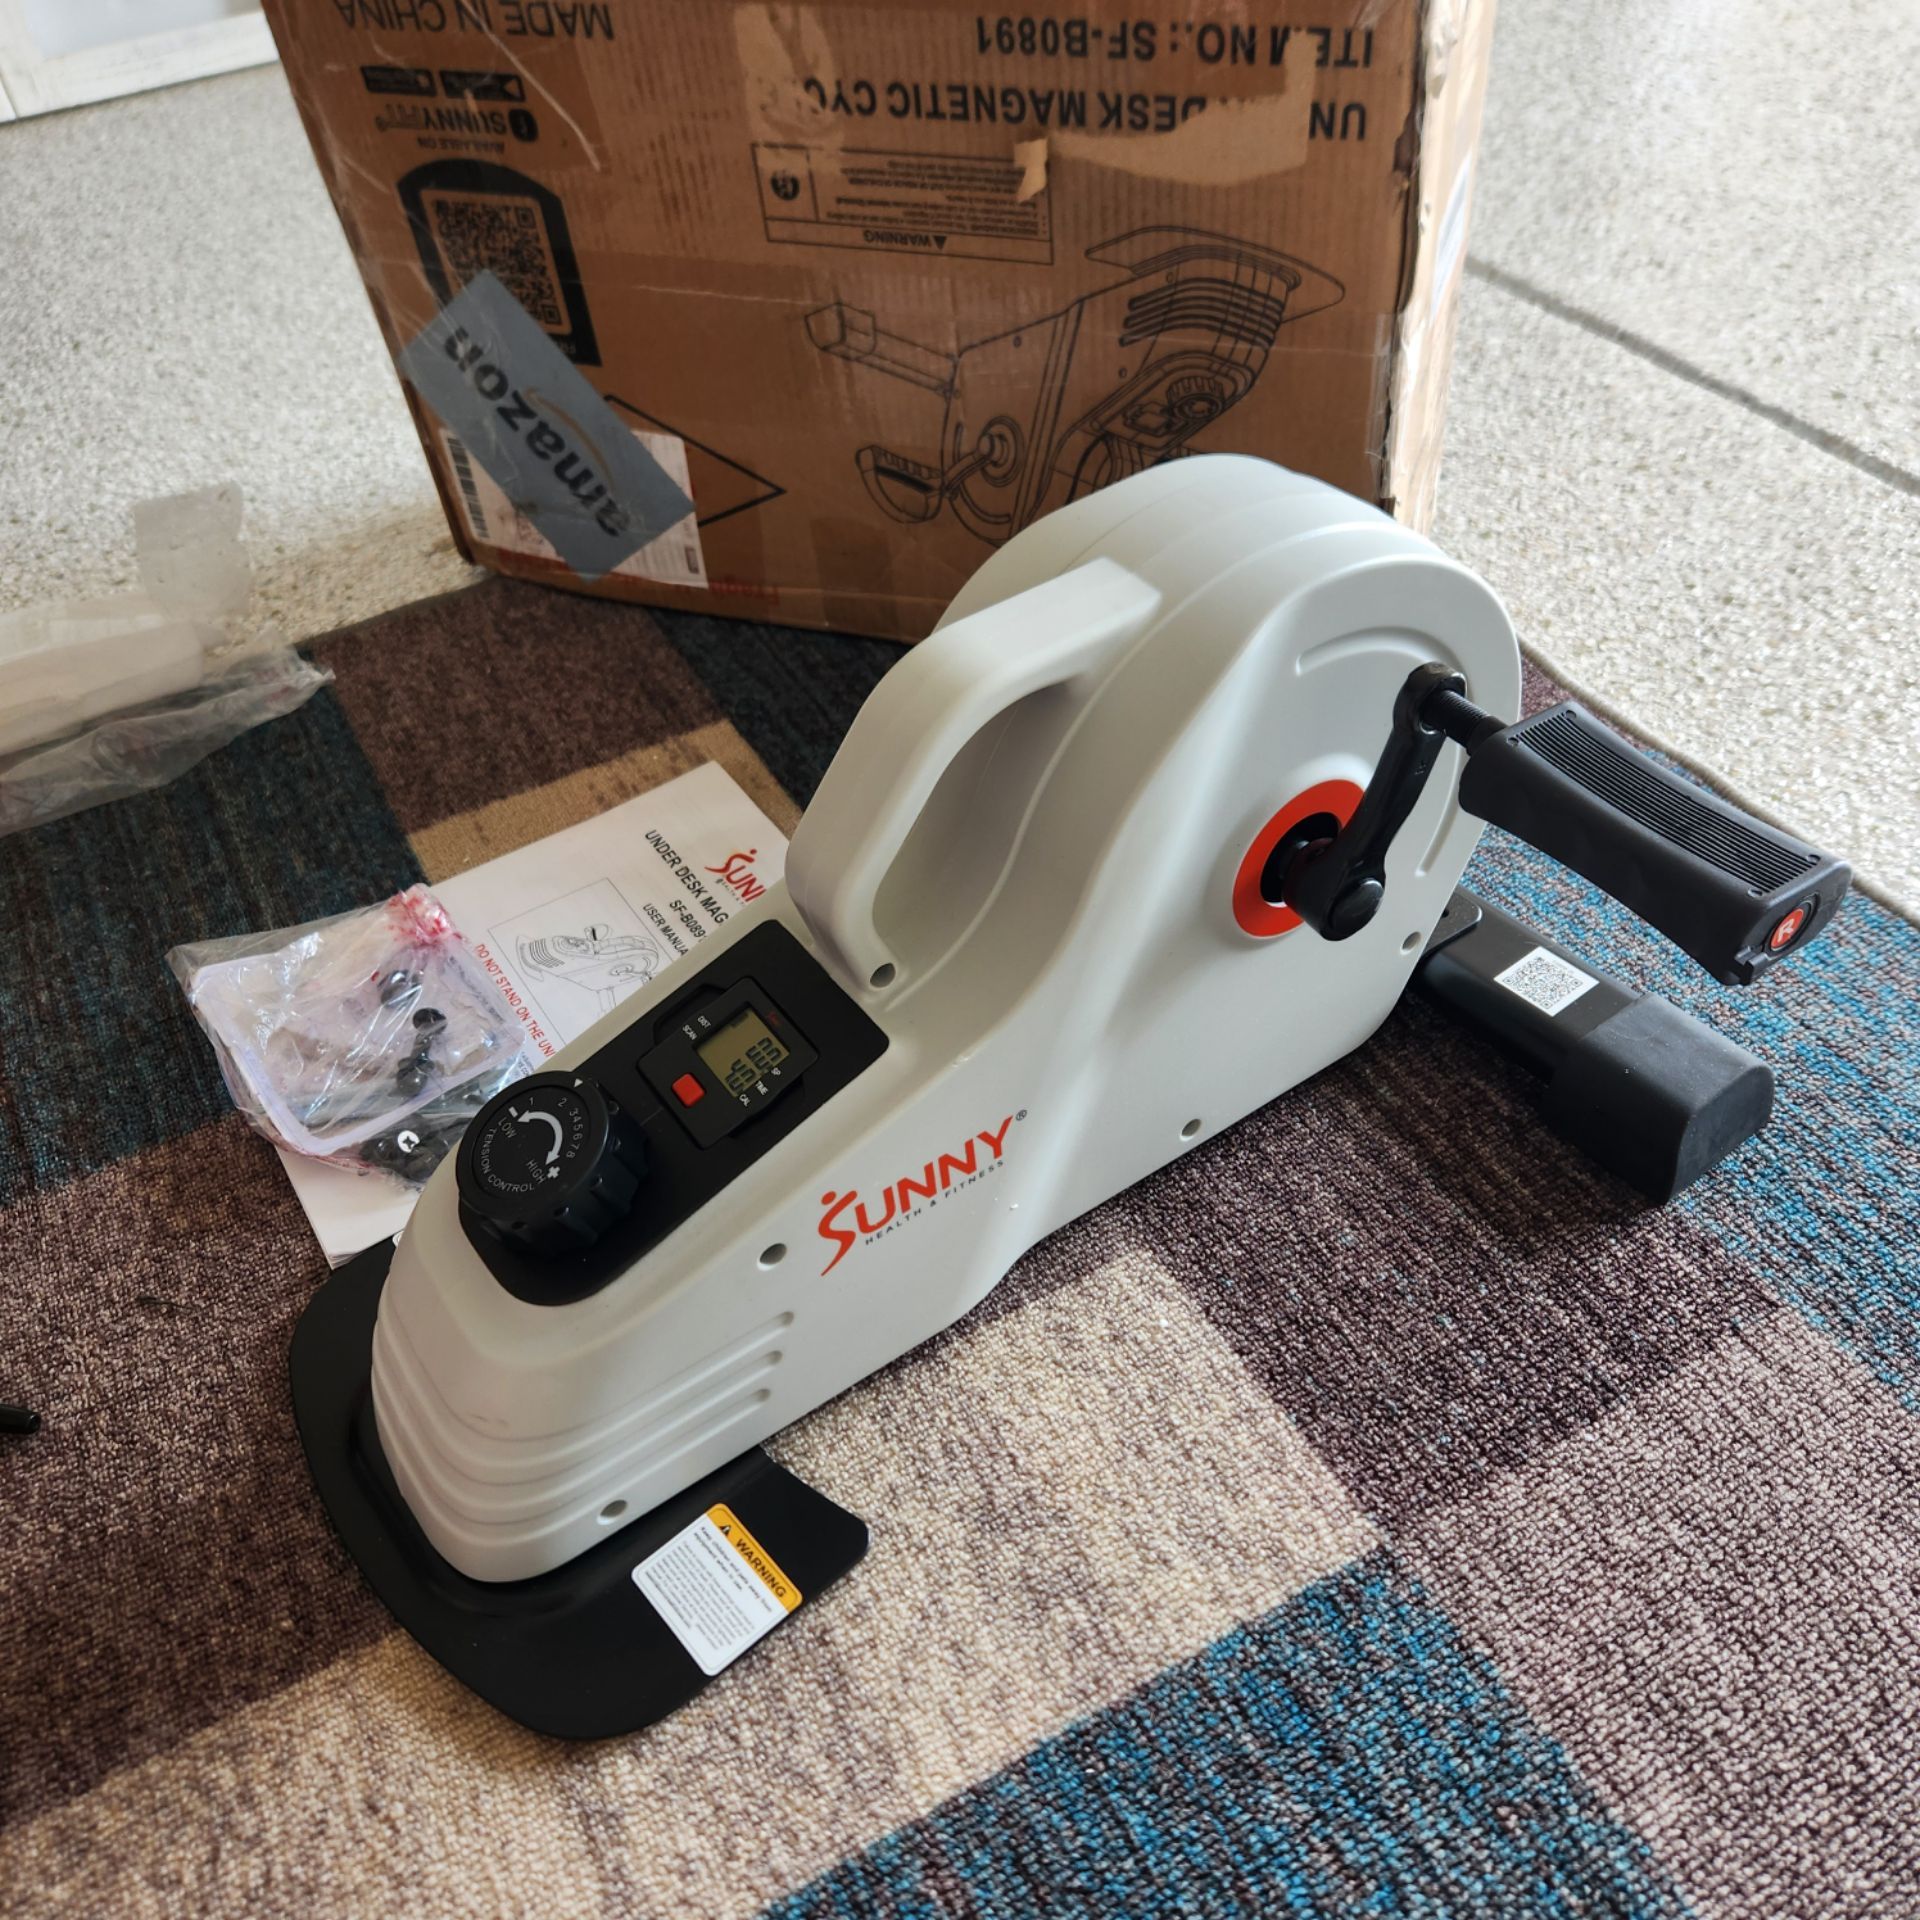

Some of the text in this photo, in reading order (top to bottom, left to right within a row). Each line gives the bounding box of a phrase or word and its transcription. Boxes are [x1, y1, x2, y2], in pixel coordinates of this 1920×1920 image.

[333, 0, 614, 40] MADE IN CHINA
[976, 16, 1157, 61] SF-B0891
[887, 80, 1086, 128] MAGNETIC
[863, 229, 932, 248] WARNING
[444, 326, 631, 538] amazon
[645, 829, 682, 869] UNDER
[674, 865, 709, 899] DESK
[643, 903, 666, 928] USER
[474, 943, 490, 959] DO
[484, 958, 504, 978] NOT
[496, 976, 522, 1008] STAND
[516, 1006, 532, 1022] ON
[526, 1020, 546, 1041] THE
[682, 1024, 698, 1041] SCAN
[697, 1015, 712, 1029] DIST
[755, 1080, 769, 1096] TIME
[557, 1098, 568, 1107] 2
[739, 1093, 751, 1107] CAL
[569, 1108, 579, 1117] 3
[498, 1117, 518, 1138] LOW
[572, 1133, 583, 1141] 6
[573, 1123, 583, 1131] 5
[480, 1127, 536, 1193] TENSION CONTROL
[565, 1151, 576, 1159] 8
[526, 1159, 548, 1184] HIGH
[865, 1159, 1004, 1246] HEALTH & FITNESS
[735, 1538, 787, 1599] WARNING
